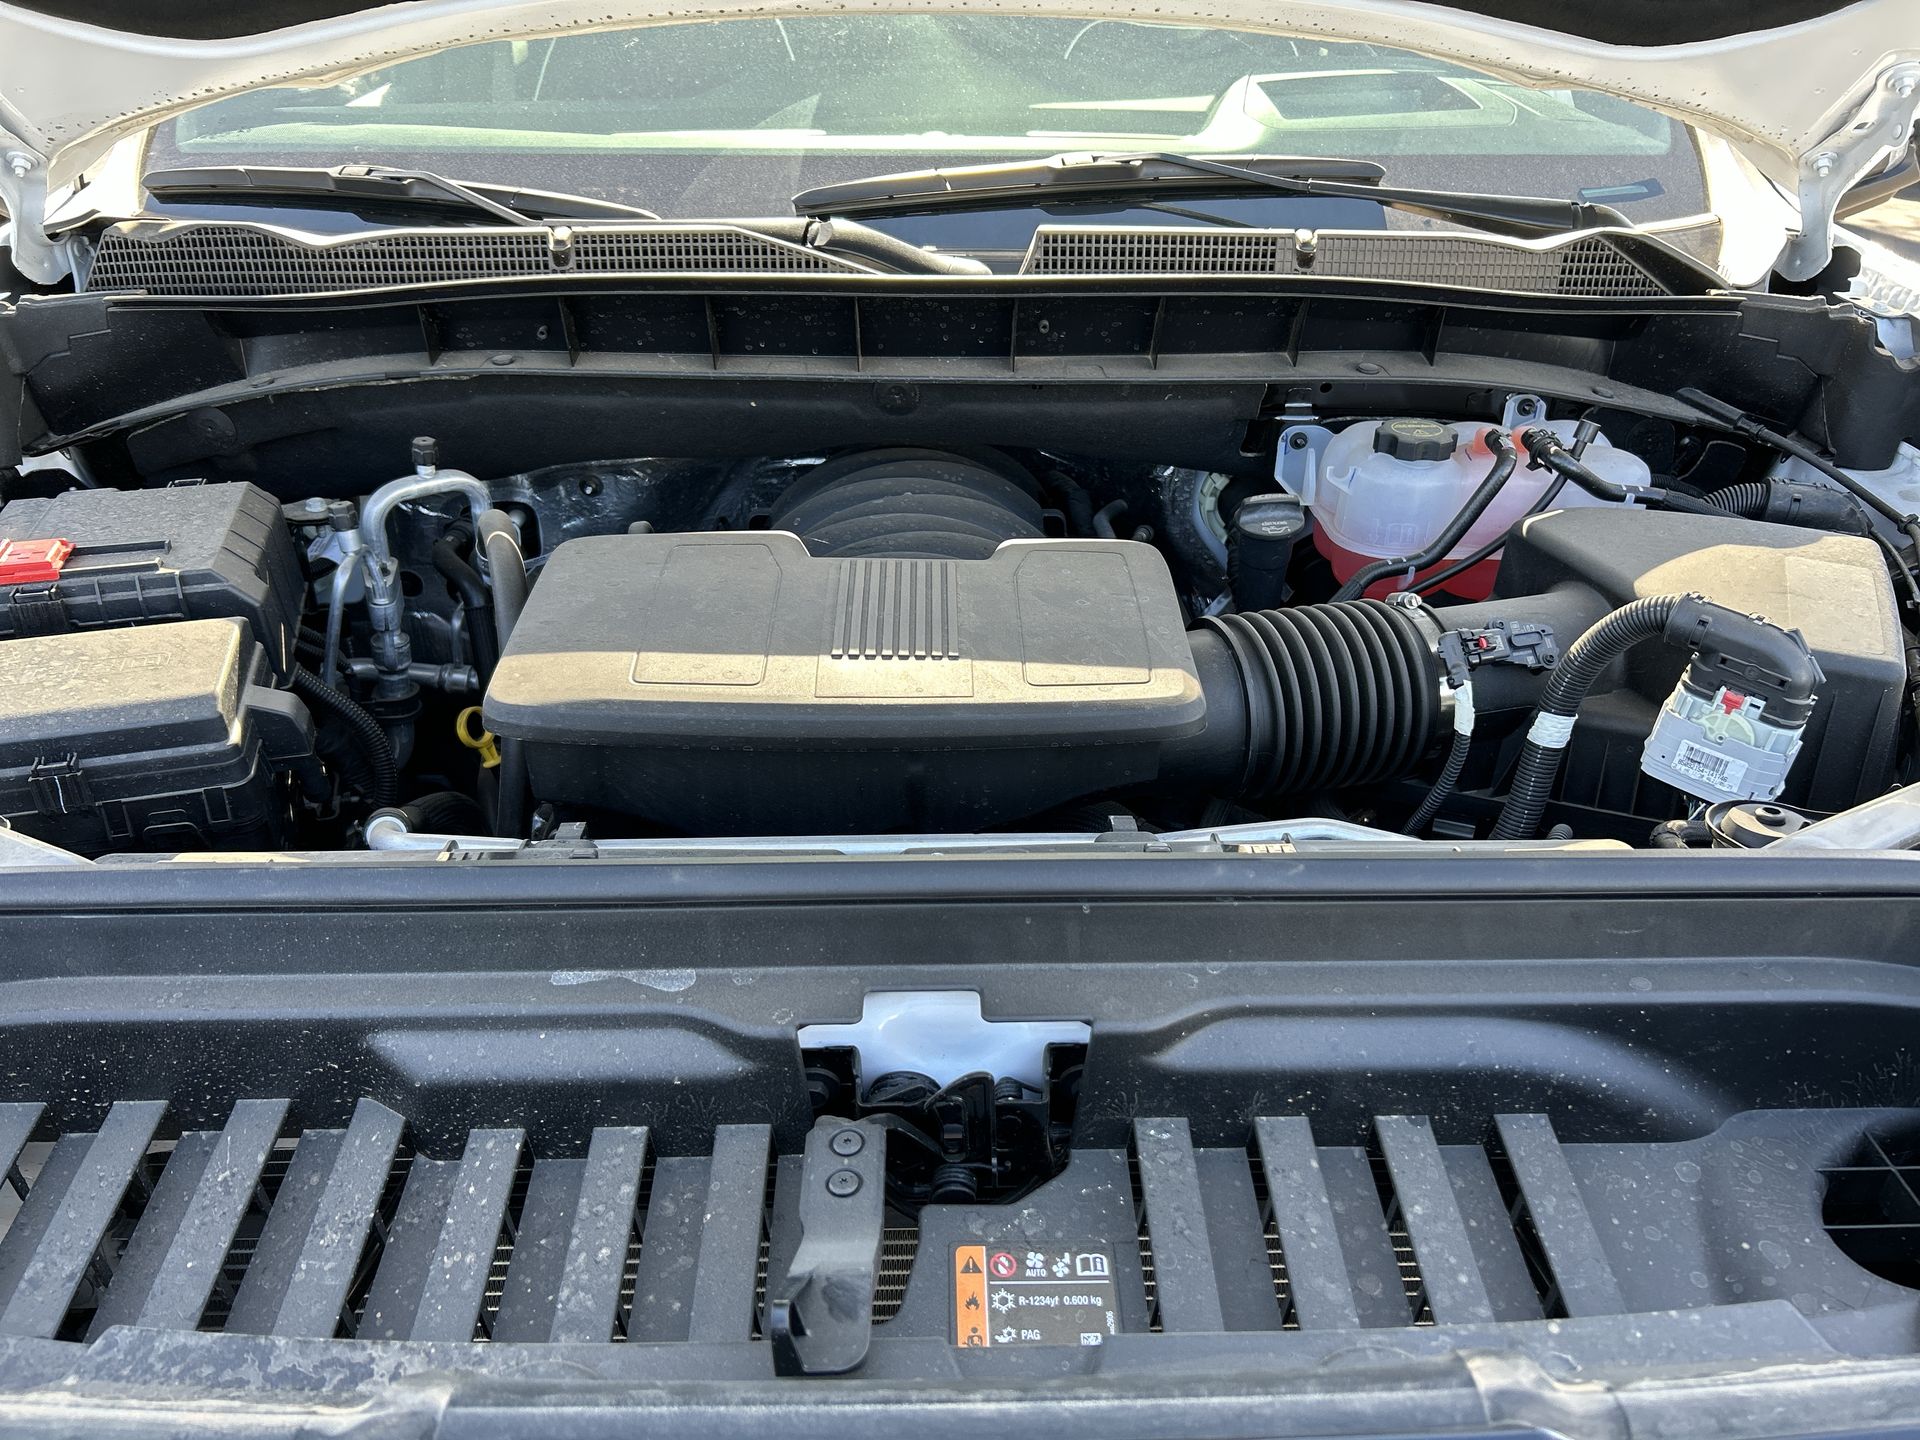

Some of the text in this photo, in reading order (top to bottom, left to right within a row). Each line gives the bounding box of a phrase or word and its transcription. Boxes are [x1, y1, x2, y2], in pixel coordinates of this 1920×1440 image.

[1025, 1269, 1047, 1277] AUTO
[1018, 1295, 1103, 1307] R-1234yf 0.600 kg
[1021, 1329, 1041, 1340] PAG
